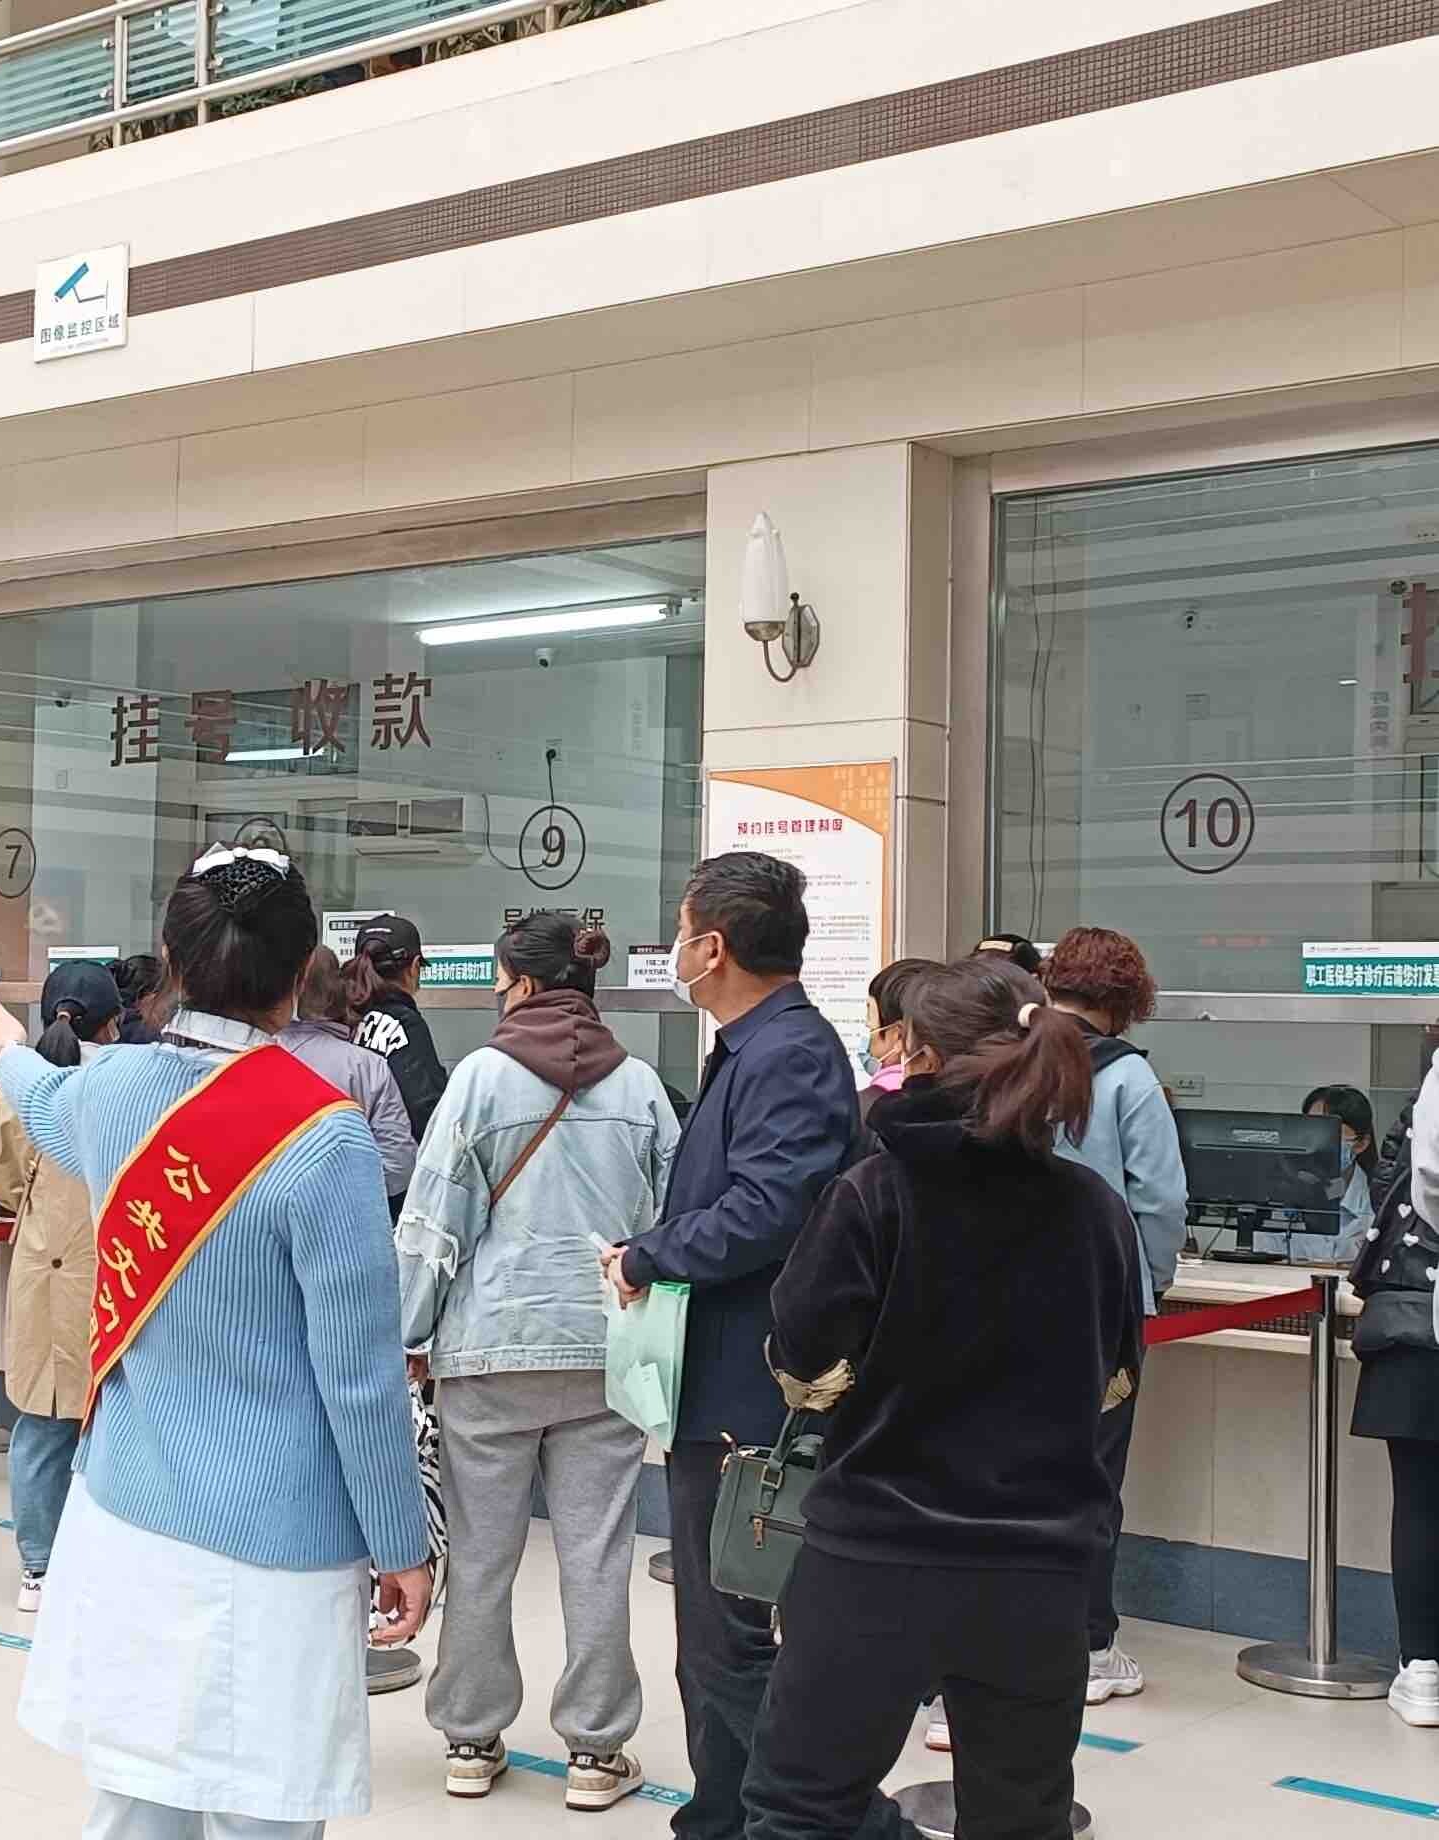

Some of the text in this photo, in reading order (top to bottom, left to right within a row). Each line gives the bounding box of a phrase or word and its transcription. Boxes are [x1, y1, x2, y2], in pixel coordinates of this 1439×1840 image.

[40, 313, 120, 344] 图像监控区域
[111, 671, 433, 768] 挂号 收款
[1175, 797, 1242, 849] 10
[502, 906, 606, 932] 异保
